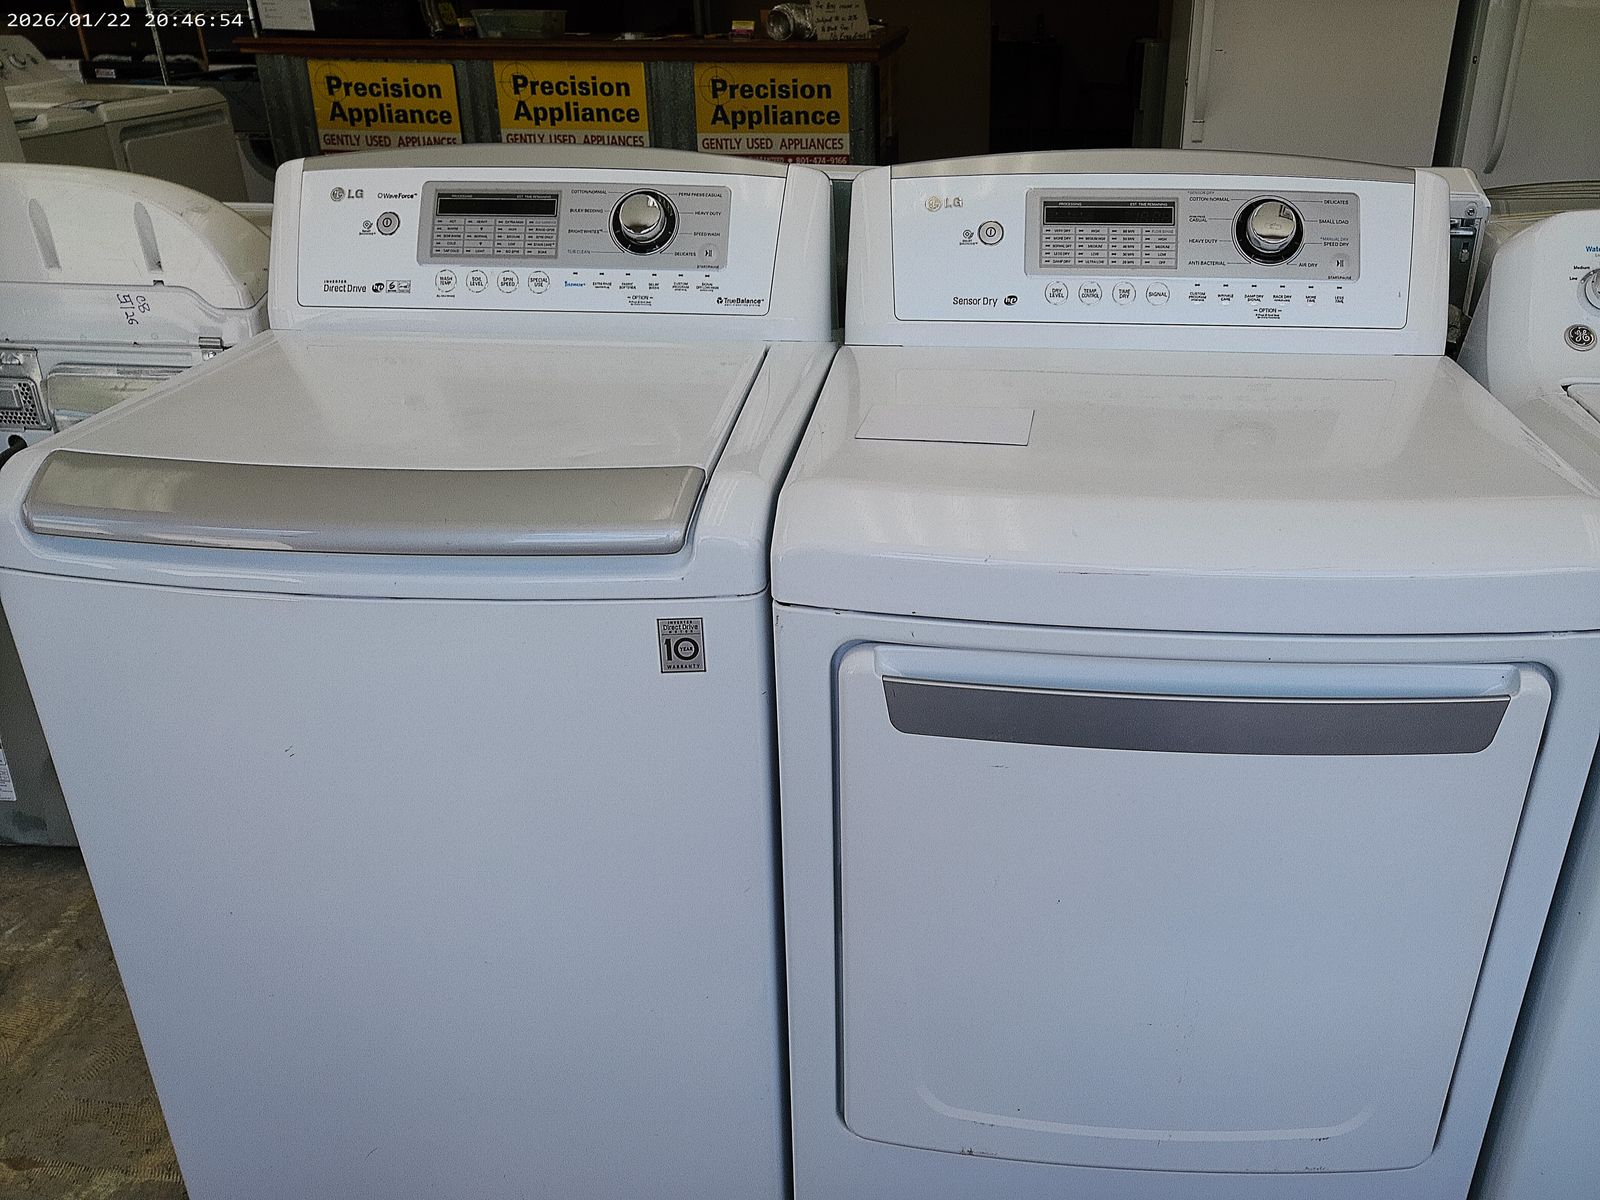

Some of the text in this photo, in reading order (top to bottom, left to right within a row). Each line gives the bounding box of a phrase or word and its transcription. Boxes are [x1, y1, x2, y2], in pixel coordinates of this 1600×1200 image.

[325, 75, 442, 99] Precision
[512, 74, 631, 97] Precision
[710, 78, 832, 99] Precision
[329, 101, 453, 127] Appliance
[513, 100, 640, 126] Appliance
[710, 104, 841, 129] Appliance
[323, 133, 361, 147] GENTLY
[365, 134, 392, 148] USED
[583, 135, 645, 147] APPLIANCES
[702, 137, 844, 150] GENTLY USED APPLIANCES
[347, 189, 364, 199] LG
[944, 197, 964, 209] LG
[323, 284, 367, 293] Direct Drive
[952, 296, 998, 307] Sensor Dry
[664, 637, 700, 661] 10
